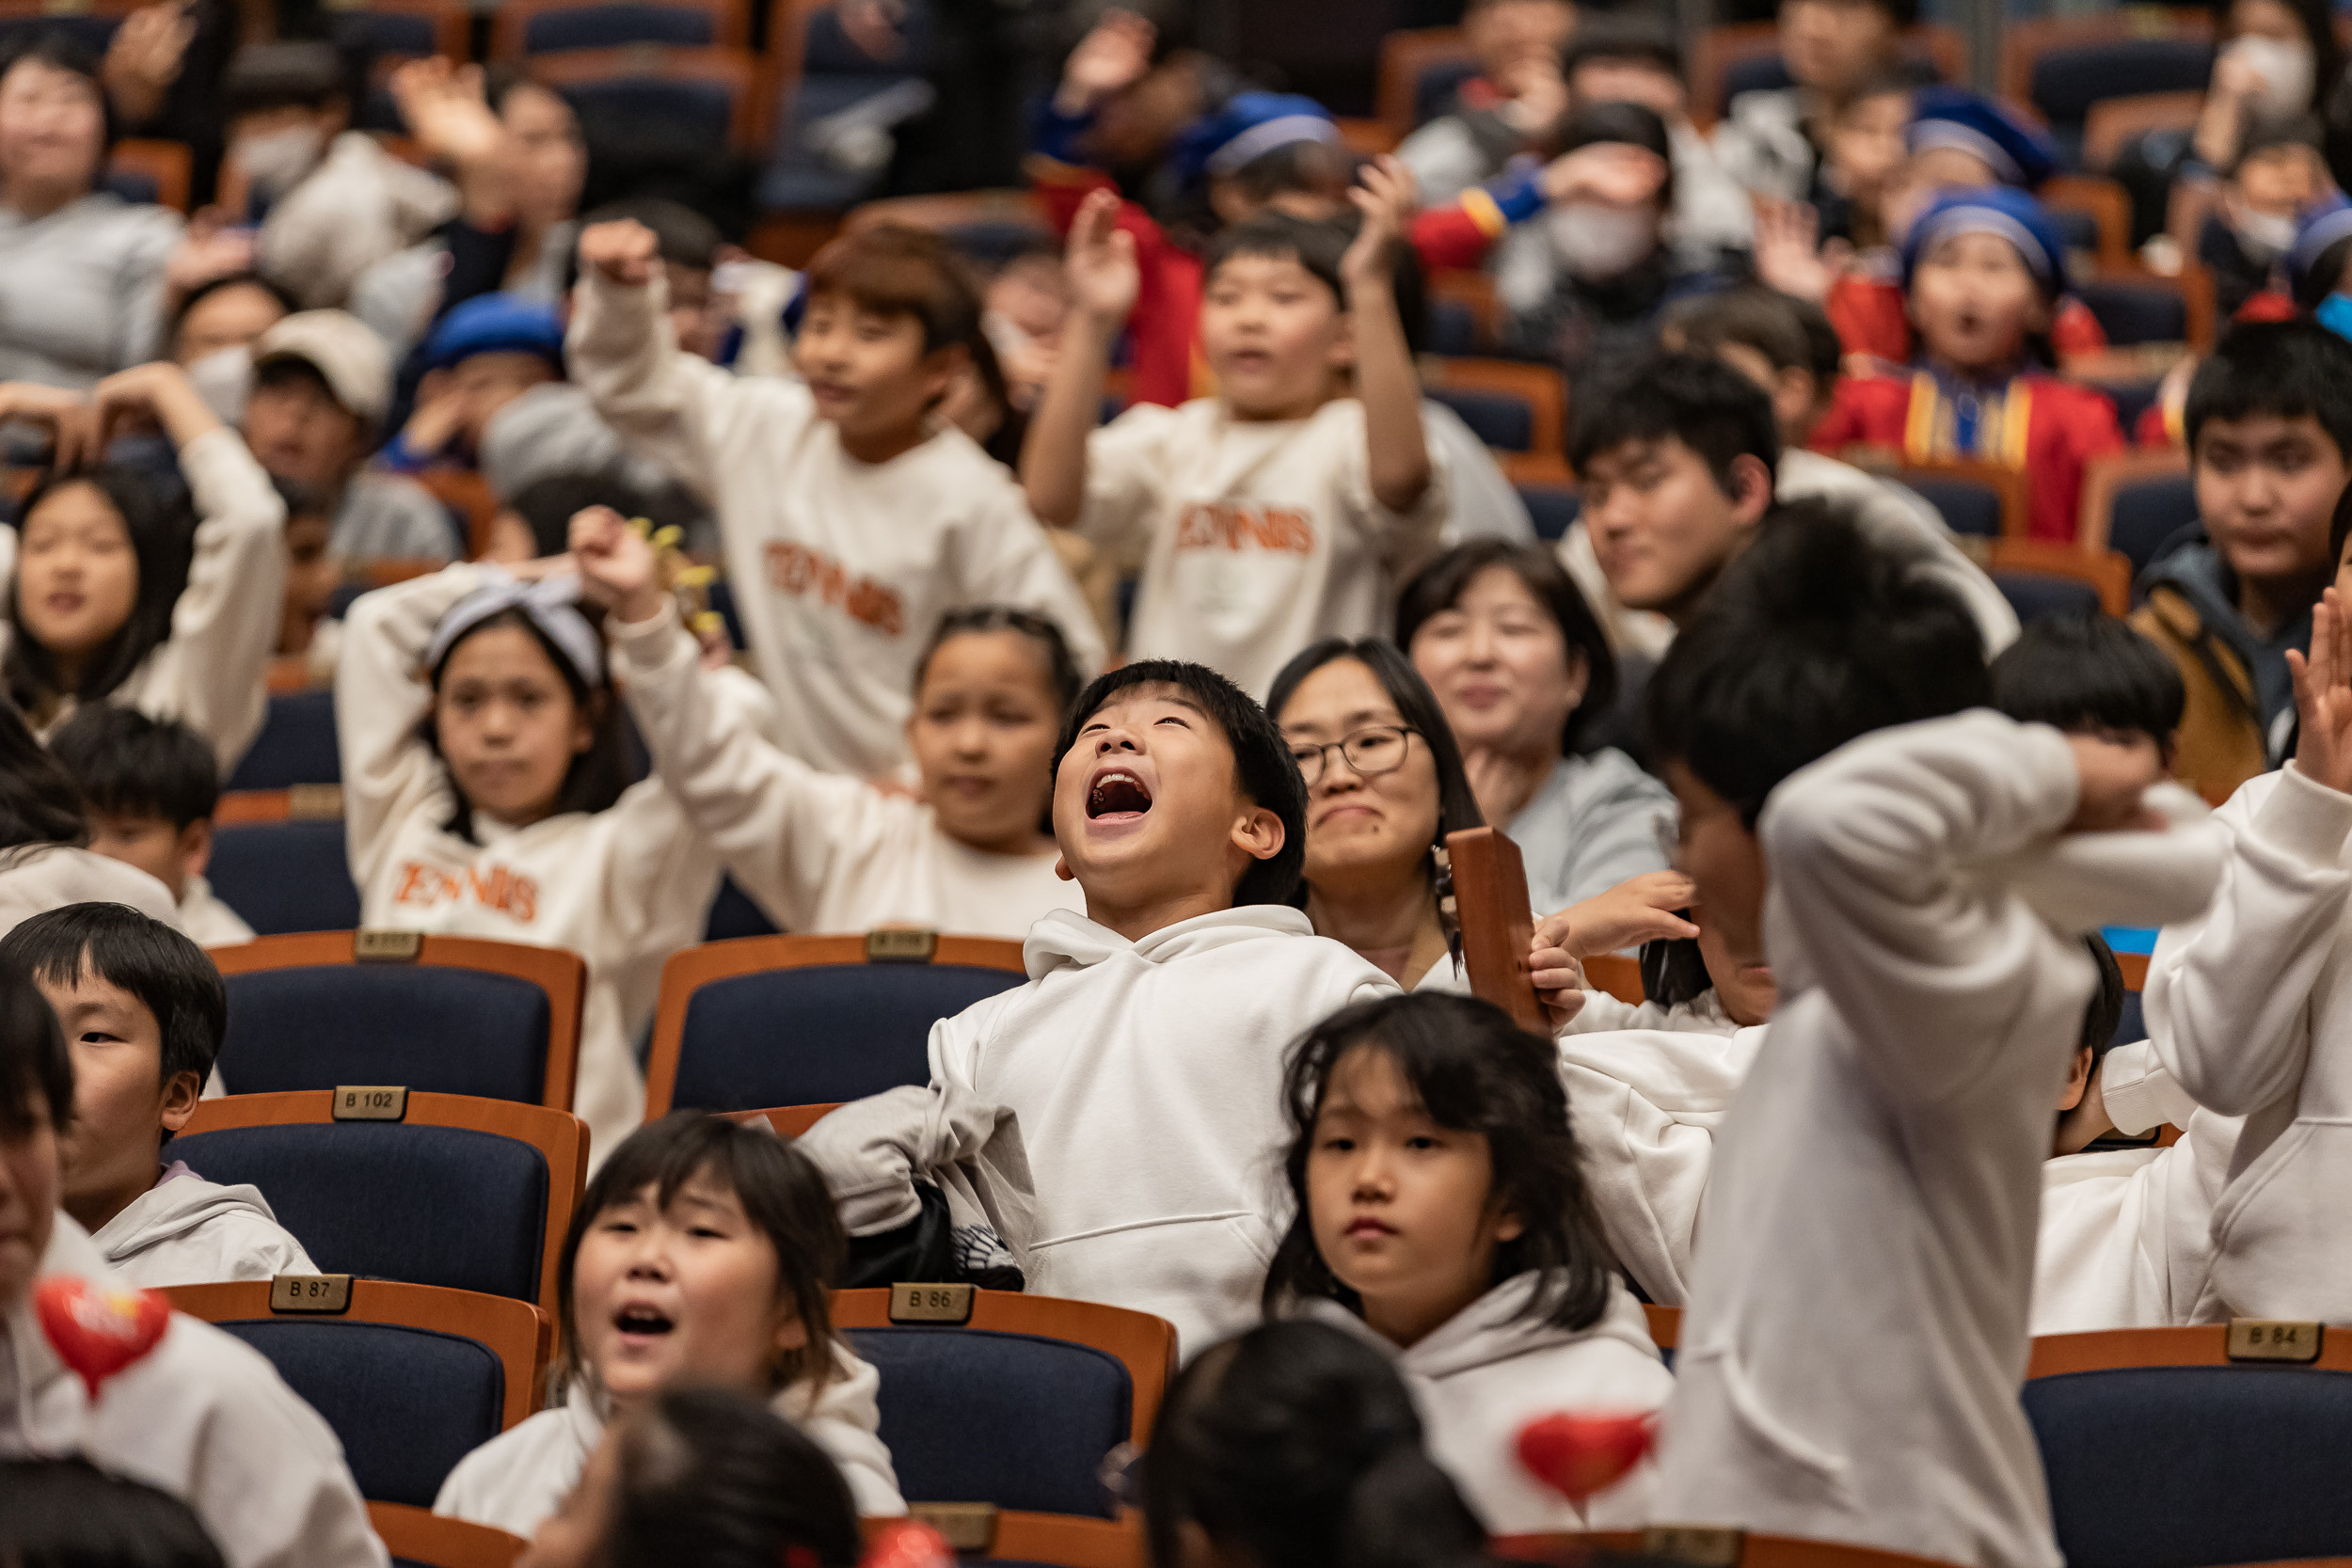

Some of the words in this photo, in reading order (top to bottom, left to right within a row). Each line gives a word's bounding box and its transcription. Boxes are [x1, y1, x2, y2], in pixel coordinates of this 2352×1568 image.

[345, 1092, 357, 1108] B
[364, 1092, 392, 1108] 102
[290, 1281, 301, 1297] B
[309, 1281, 330, 1297] 87
[910, 1291, 921, 1307] B
[930, 1291, 951, 1307] 86
[2249, 1326, 2263, 1345] B
